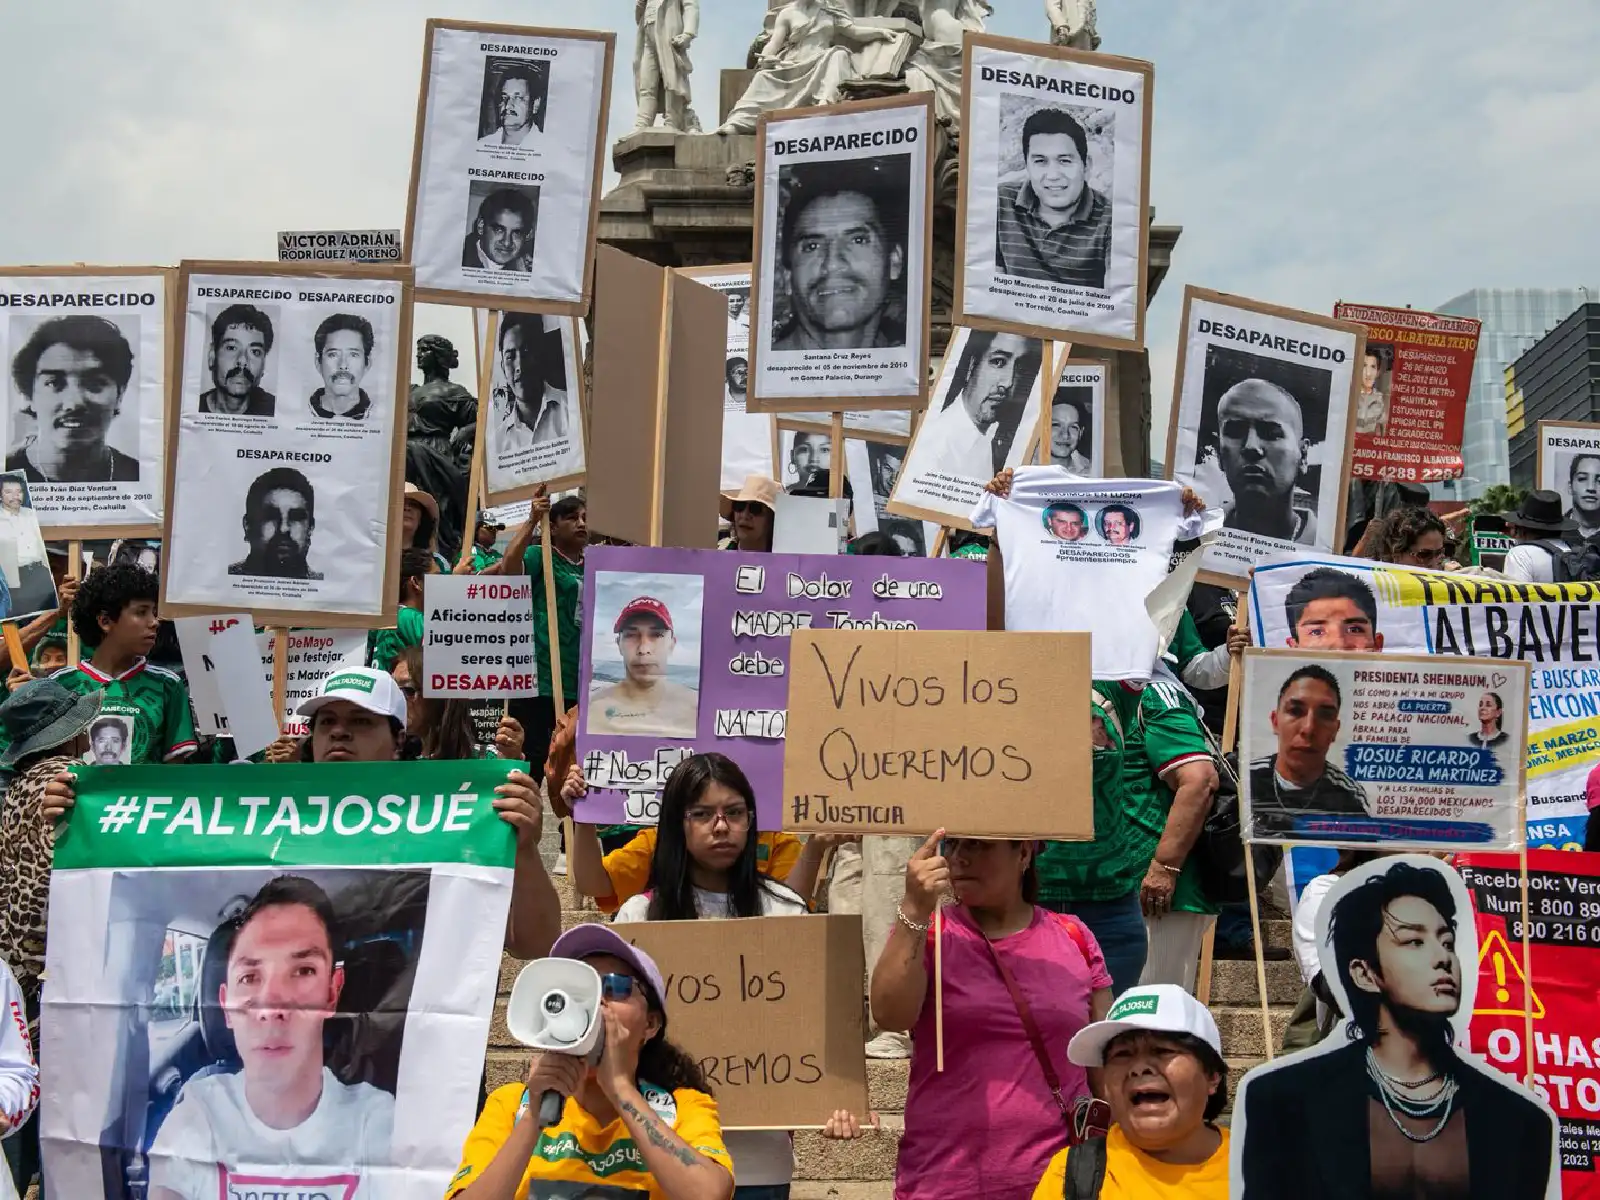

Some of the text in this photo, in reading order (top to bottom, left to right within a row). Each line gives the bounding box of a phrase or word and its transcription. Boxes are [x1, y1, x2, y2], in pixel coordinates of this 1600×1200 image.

[480, 43, 558, 56] DESAPARECIDO
[981, 65, 1135, 105] DESAPARECIDO
[774, 127, 918, 155] DESAPARECIDO
[468, 167, 545, 181] DESAPARECIDO
[283, 231, 393, 248] VICTOR ADRIÁN
[349, 249, 398, 260] MORENO
[993, 276, 1014, 287] Hugo
[1014, 279, 1050, 292] Marcelino
[0, 293, 155, 307] DESAPARECIDO
[197, 287, 292, 301] DESAPARECIDO
[298, 291, 395, 305] DESAPARECIDO
[989, 285, 1037, 300] desaparecido
[1058, 296, 1067, 304] de
[1068, 297, 1085, 308] julio
[1087, 299, 1095, 307] de
[1057, 306, 1089, 317] Coahuila
[1198, 319, 1346, 364] DESAPARECIDO
[833, 352, 849, 360] Cruz
[850, 352, 872, 361] Reyes
[767, 364, 813, 372] desaparecido
[889, 361, 908, 369] 2010
[854, 373, 883, 382] Durango
[1061, 374, 1101, 383] RECIDO
[237, 448, 332, 463] DESAPARECIDO
[1353, 464, 1374, 476] 55
[77, 493, 120, 502] septiembre
[1110, 492, 1142, 500] LUCHA
[93, 503, 127, 511] Coahuila
[736, 567, 763, 591] El
[873, 573, 899, 597] de
[908, 580, 940, 598] una
[467, 583, 532, 600] #10DeM
[431, 609, 522, 622] Aficionados
[268, 636, 334, 651] #DeMayo
[429, 631, 505, 647] juguemos
[303, 651, 345, 664] festejar,
[461, 655, 503, 665] seres
[730, 652, 783, 674] debe
[1354, 671, 1490, 688] PRESIDENTA SHEINBAUM,
[1542, 669, 1600, 691] BUSCAR
[1368, 689, 1391, 697] COMO
[1438, 692, 1465, 700] GRUPO
[1353, 701, 1369, 709] NOS
[1401, 703, 1412, 711] LA
[1416, 704, 1447, 712] PUERTA
[1353, 712, 1470, 727] DE PALACIO NACIONAL,
[1388, 726, 1408, 734] PARA
[1353, 734, 1411, 744] LA FAMILIA DE
[1543, 727, 1598, 752] MARZO
[820, 727, 1032, 791] QUEREMOS
[1353, 744, 1480, 767] JOSUÉ RICARDO
[1354, 765, 1498, 783] MENDOZA MARTÍNEZ
[1408, 786, 1444, 794] FAMILIAS
[1376, 796, 1394, 805] LOS
[1438, 798, 1495, 808] MEXICANOS
[1531, 789, 1588, 806] Buscand
[98, 781, 479, 836] #FALTAJOSUÉ
[791, 795, 905, 824] #JUSTICIA
[1376, 806, 1452, 818] DESAPARECIDOS
[1526, 823, 1571, 840] NSA
[1541, 898, 1573, 916] 800
[1553, 923, 1587, 940] 216
[700, 1052, 824, 1086] REMOS
[1563, 1154, 1589, 1166] 2023
